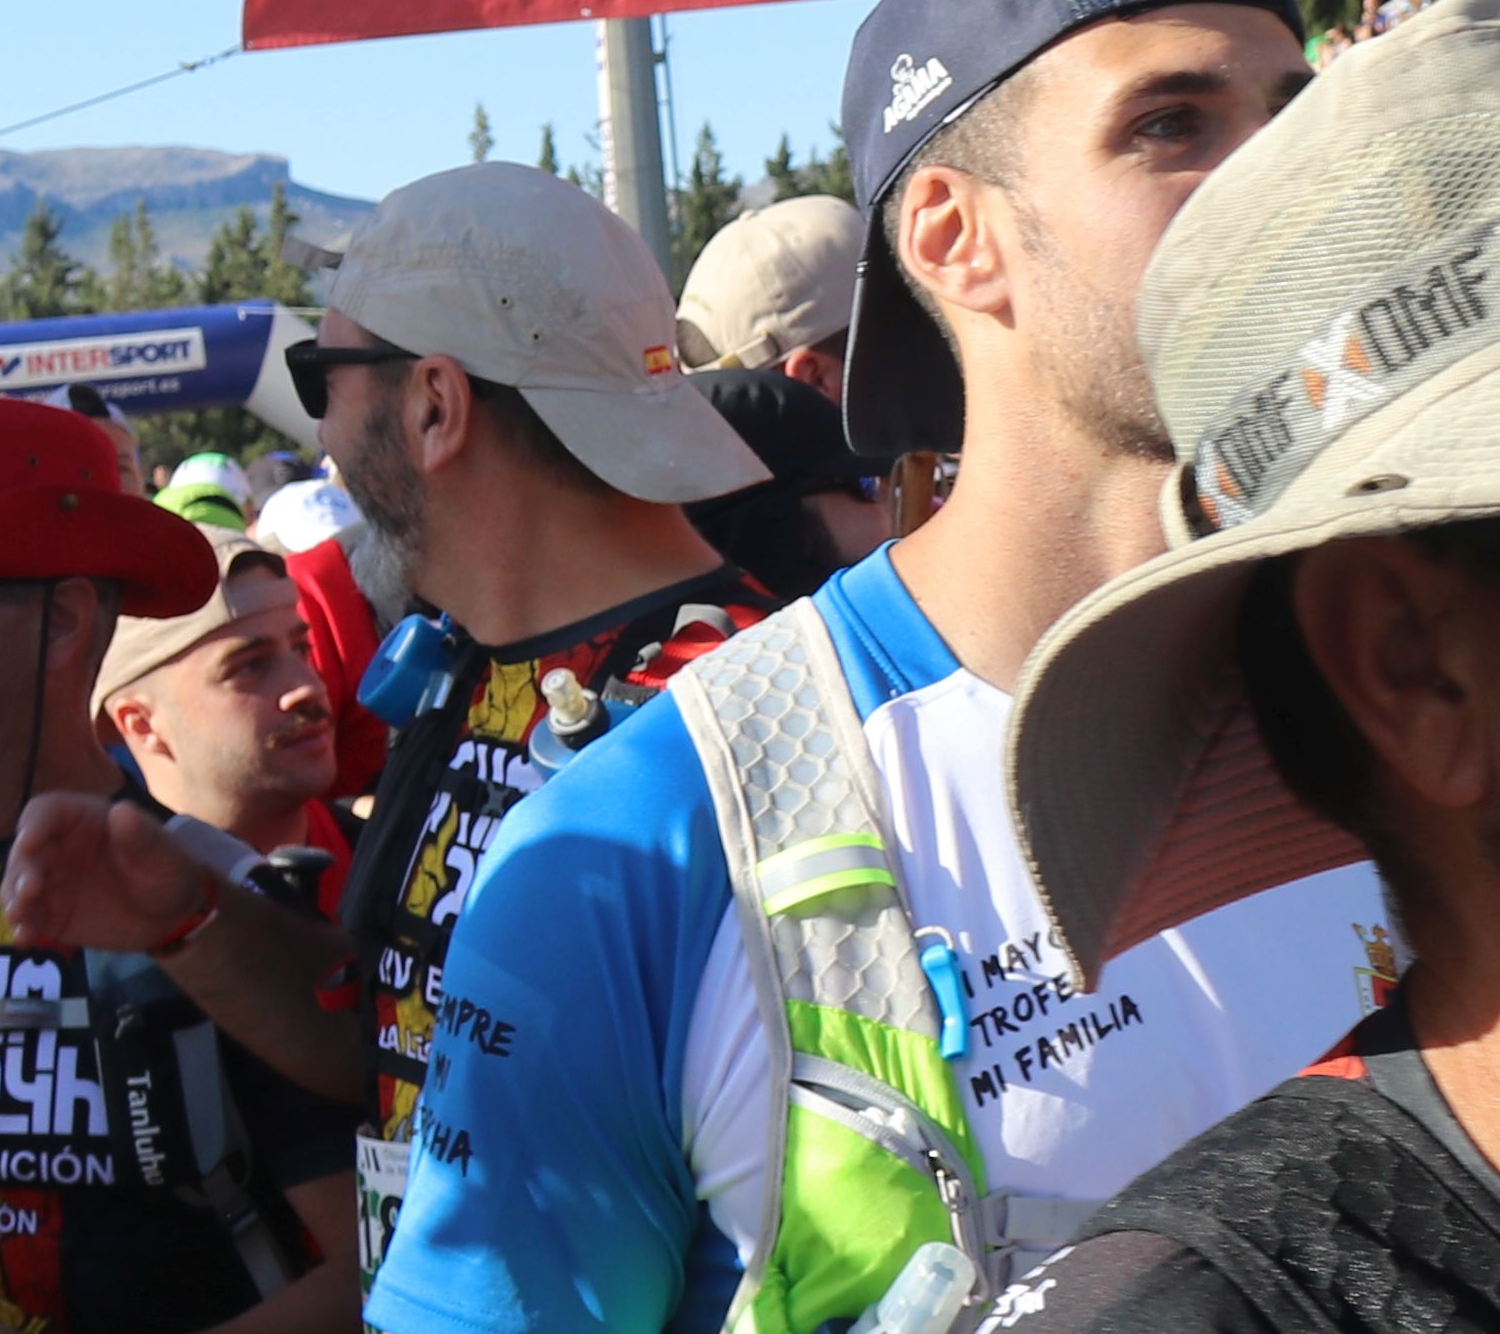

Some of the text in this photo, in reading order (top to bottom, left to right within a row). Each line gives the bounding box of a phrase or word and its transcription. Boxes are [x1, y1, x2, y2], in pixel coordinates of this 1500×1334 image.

[883, 57, 947, 133] AGAMA
[26, 340, 191, 374] INTERSPORT
[970, 995, 1144, 1108] MI FAMILIA
